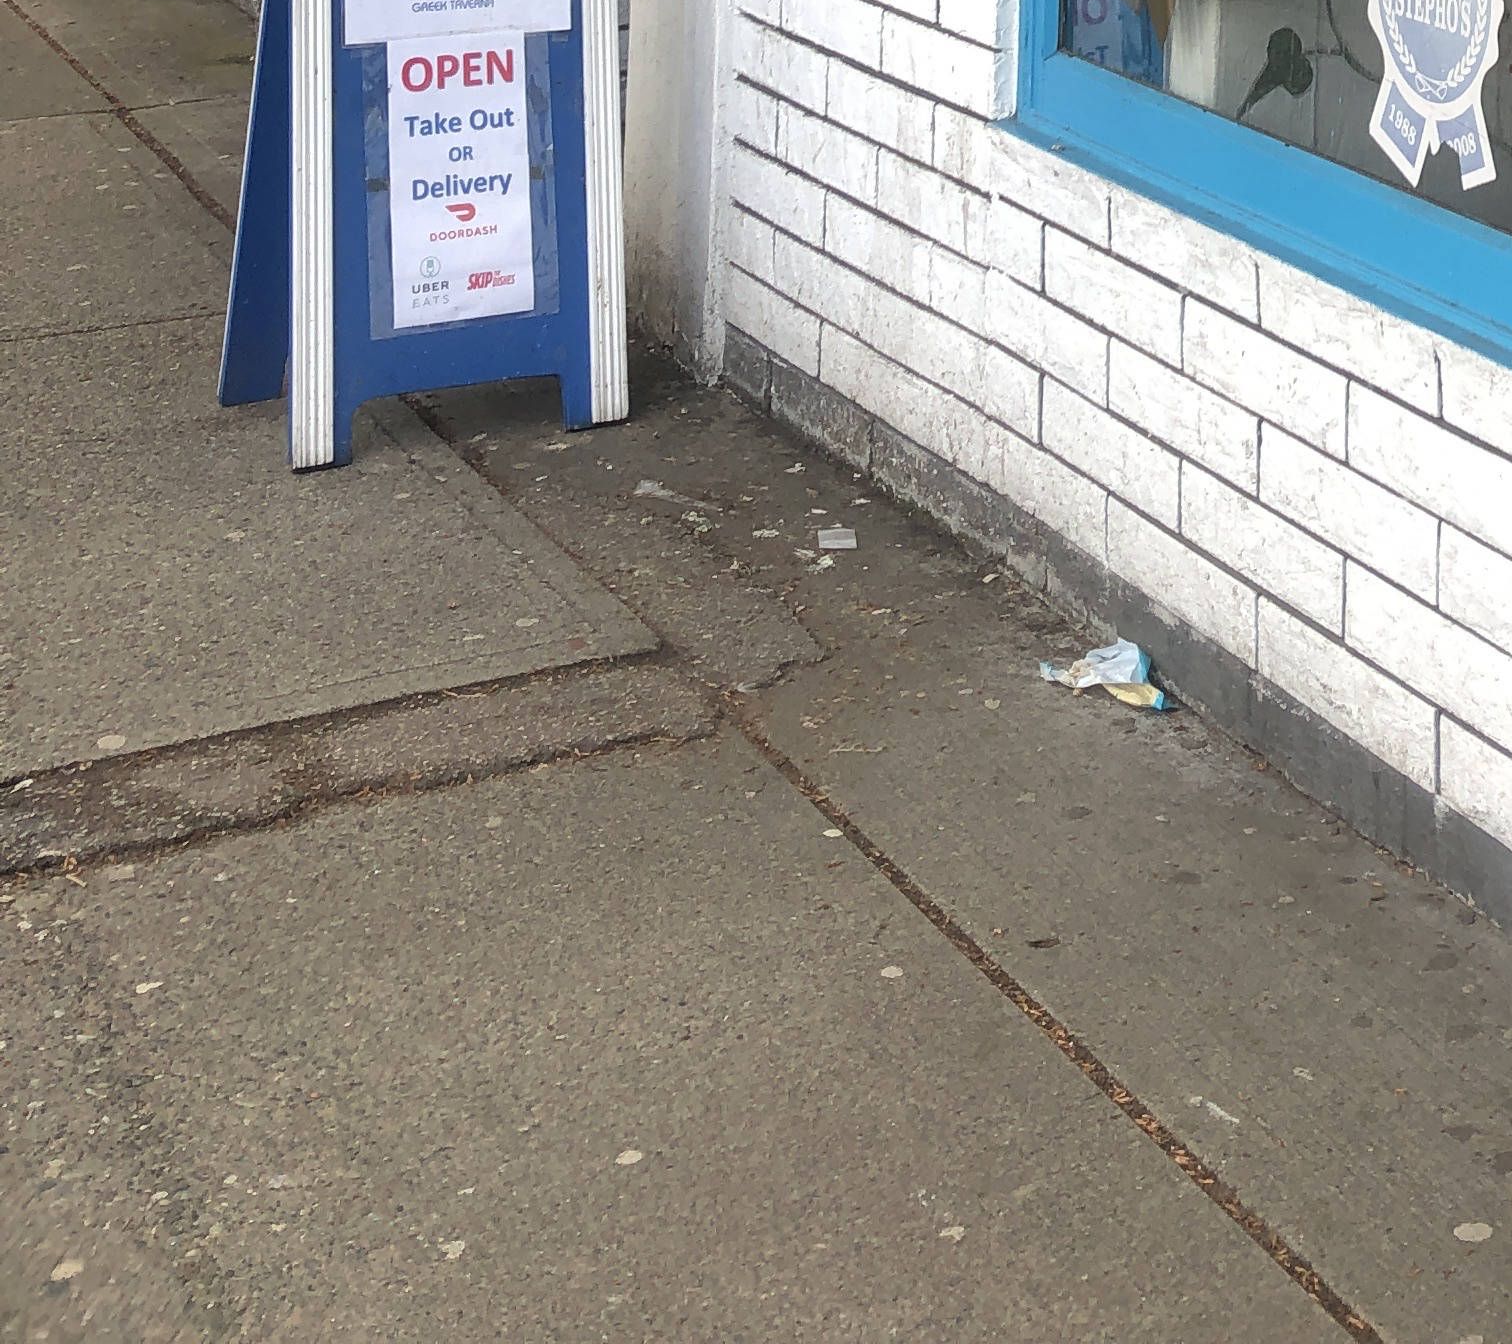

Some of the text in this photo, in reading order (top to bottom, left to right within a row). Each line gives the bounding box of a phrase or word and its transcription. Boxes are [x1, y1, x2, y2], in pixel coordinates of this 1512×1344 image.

[411, 0, 448, 13] GREEK
[401, 48, 514, 92] OPEN
[404, 107, 515, 137] Take Out
[1388, 103, 1417, 146] 1988
[448, 146, 474, 162] OR
[412, 173, 512, 201] Delivery
[429, 225, 498, 242] DOORDASH
[412, 280, 449, 294] UBER
[467, 271, 493, 290] SKIP
[412, 295, 450, 309] EATS
